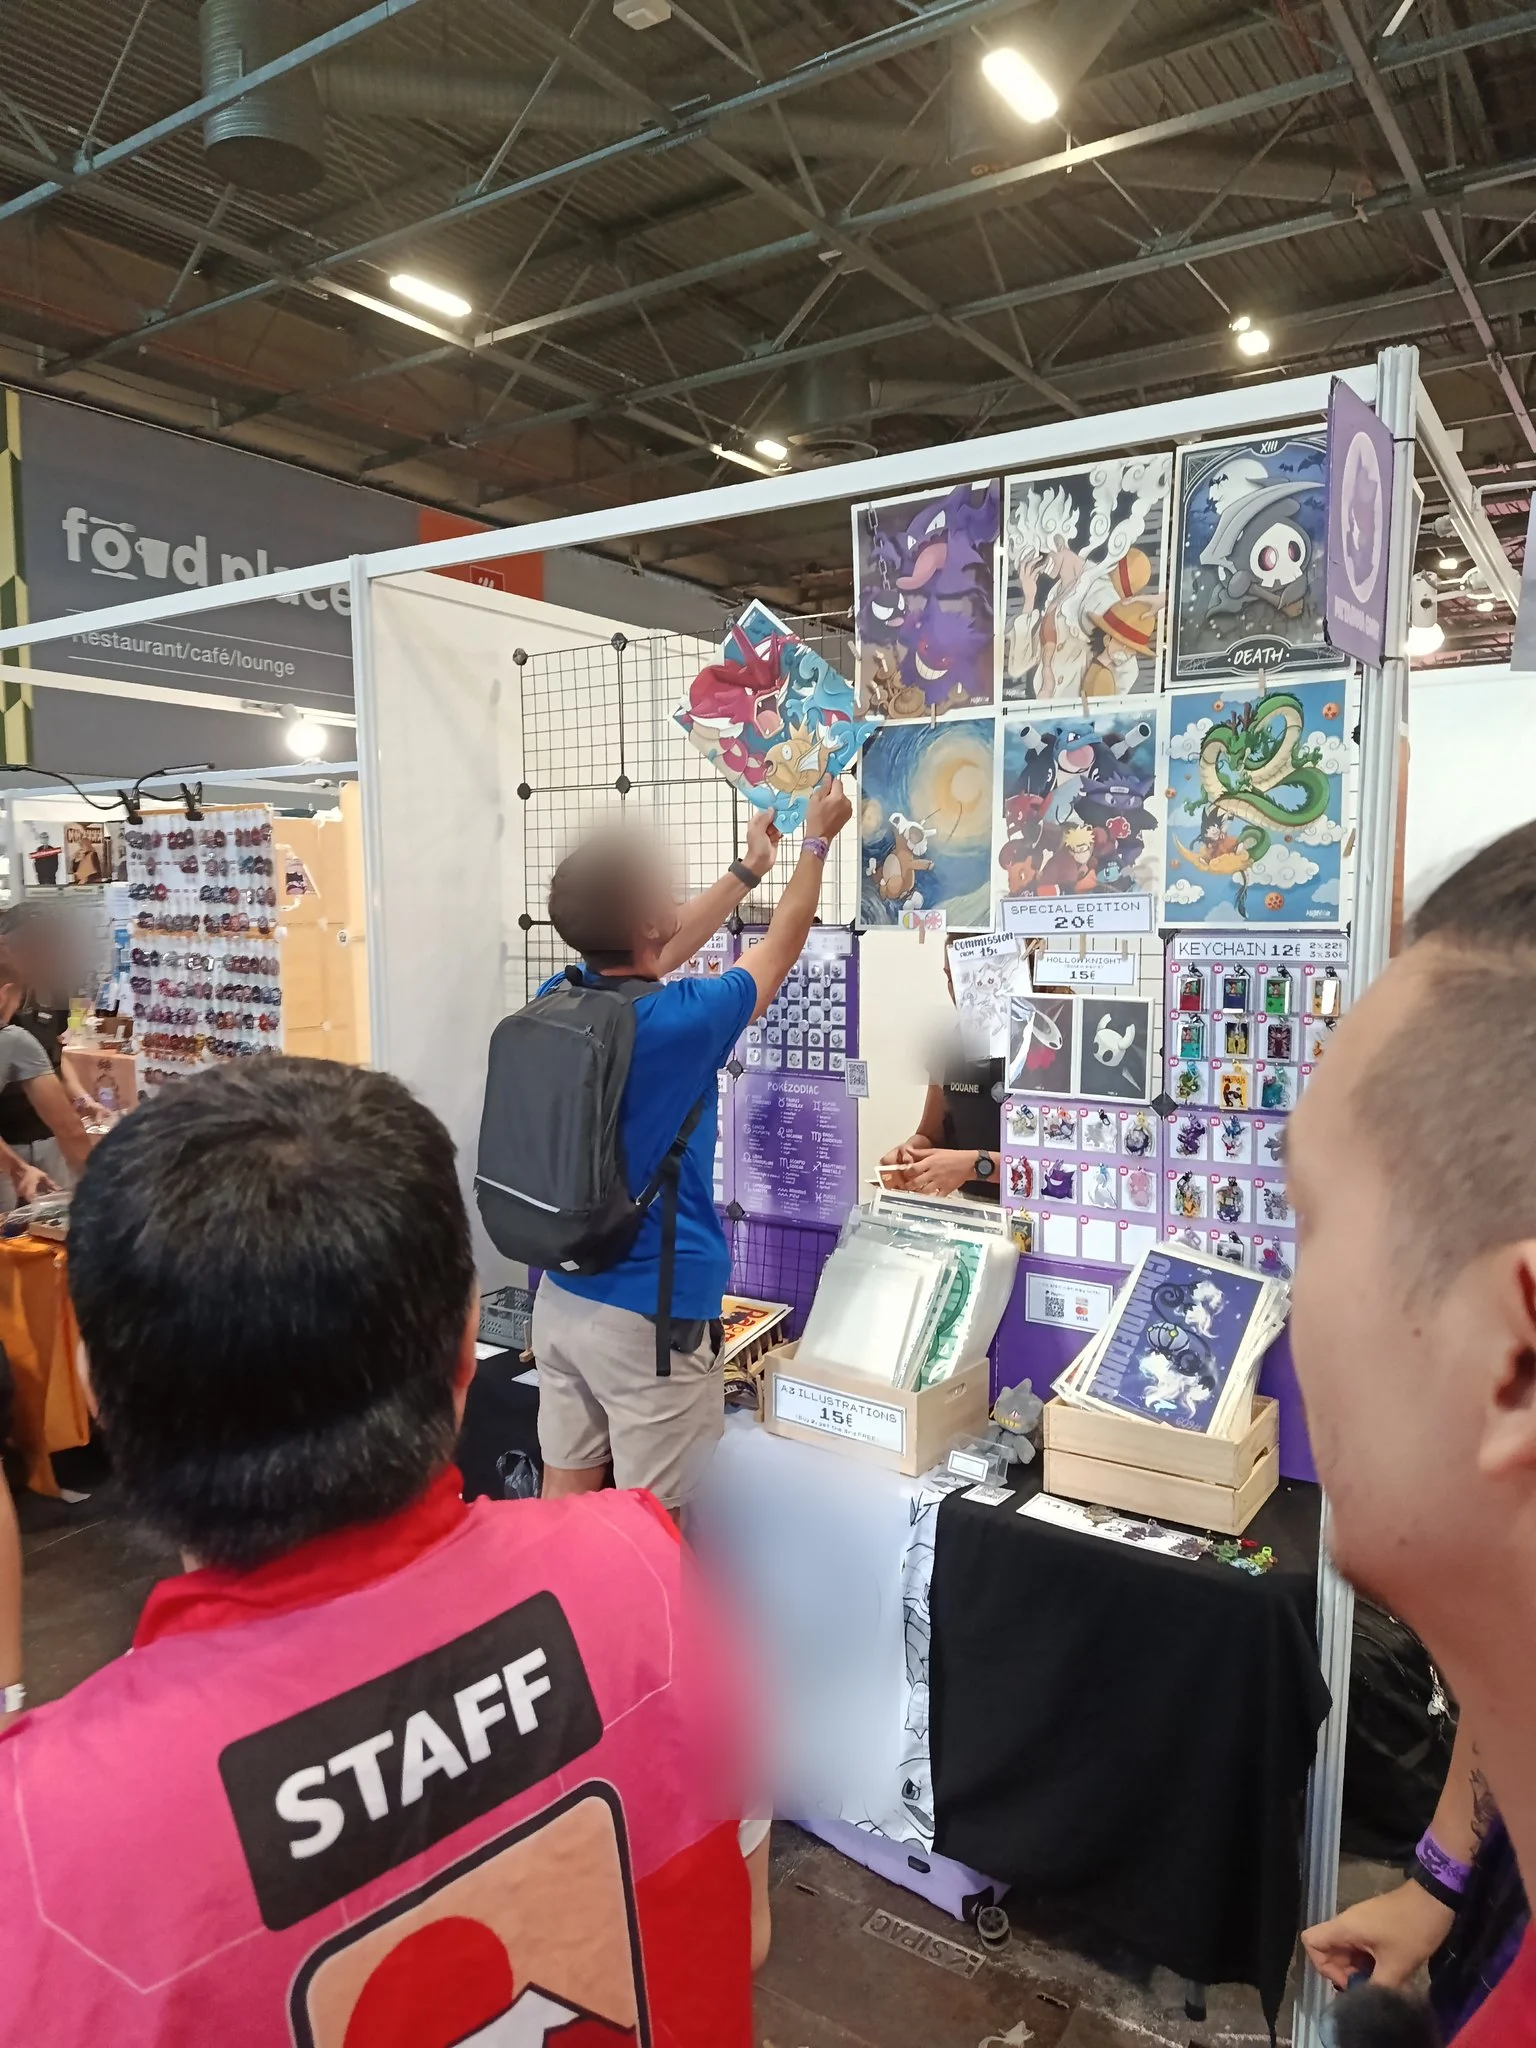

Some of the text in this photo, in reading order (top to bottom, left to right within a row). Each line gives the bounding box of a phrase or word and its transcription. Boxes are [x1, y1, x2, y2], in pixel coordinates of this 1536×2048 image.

[1259, 440, 1278, 454] XIII
[1233, 647, 1285, 666] DEATH
[1010, 902, 1140, 915] SPECIAL EDITION
[1054, 915, 1095, 929] 20€
[1179, 942, 1301, 957] KEYCHAIN 12€
[1085, 957, 1122, 965] KNIGHT
[1069, 970, 1096, 980] 15€
[767, 1081, 820, 1095] POKÉZODIAC
[950, 1082, 980, 1093] DOUANE
[1087, 1253, 1171, 1401] CHANDELURE
[780, 1384, 897, 1424] A3 ILLUSTRATIONS
[819, 1407, 853, 1427] 15€
[275, 1646, 552, 1860] STAFF
